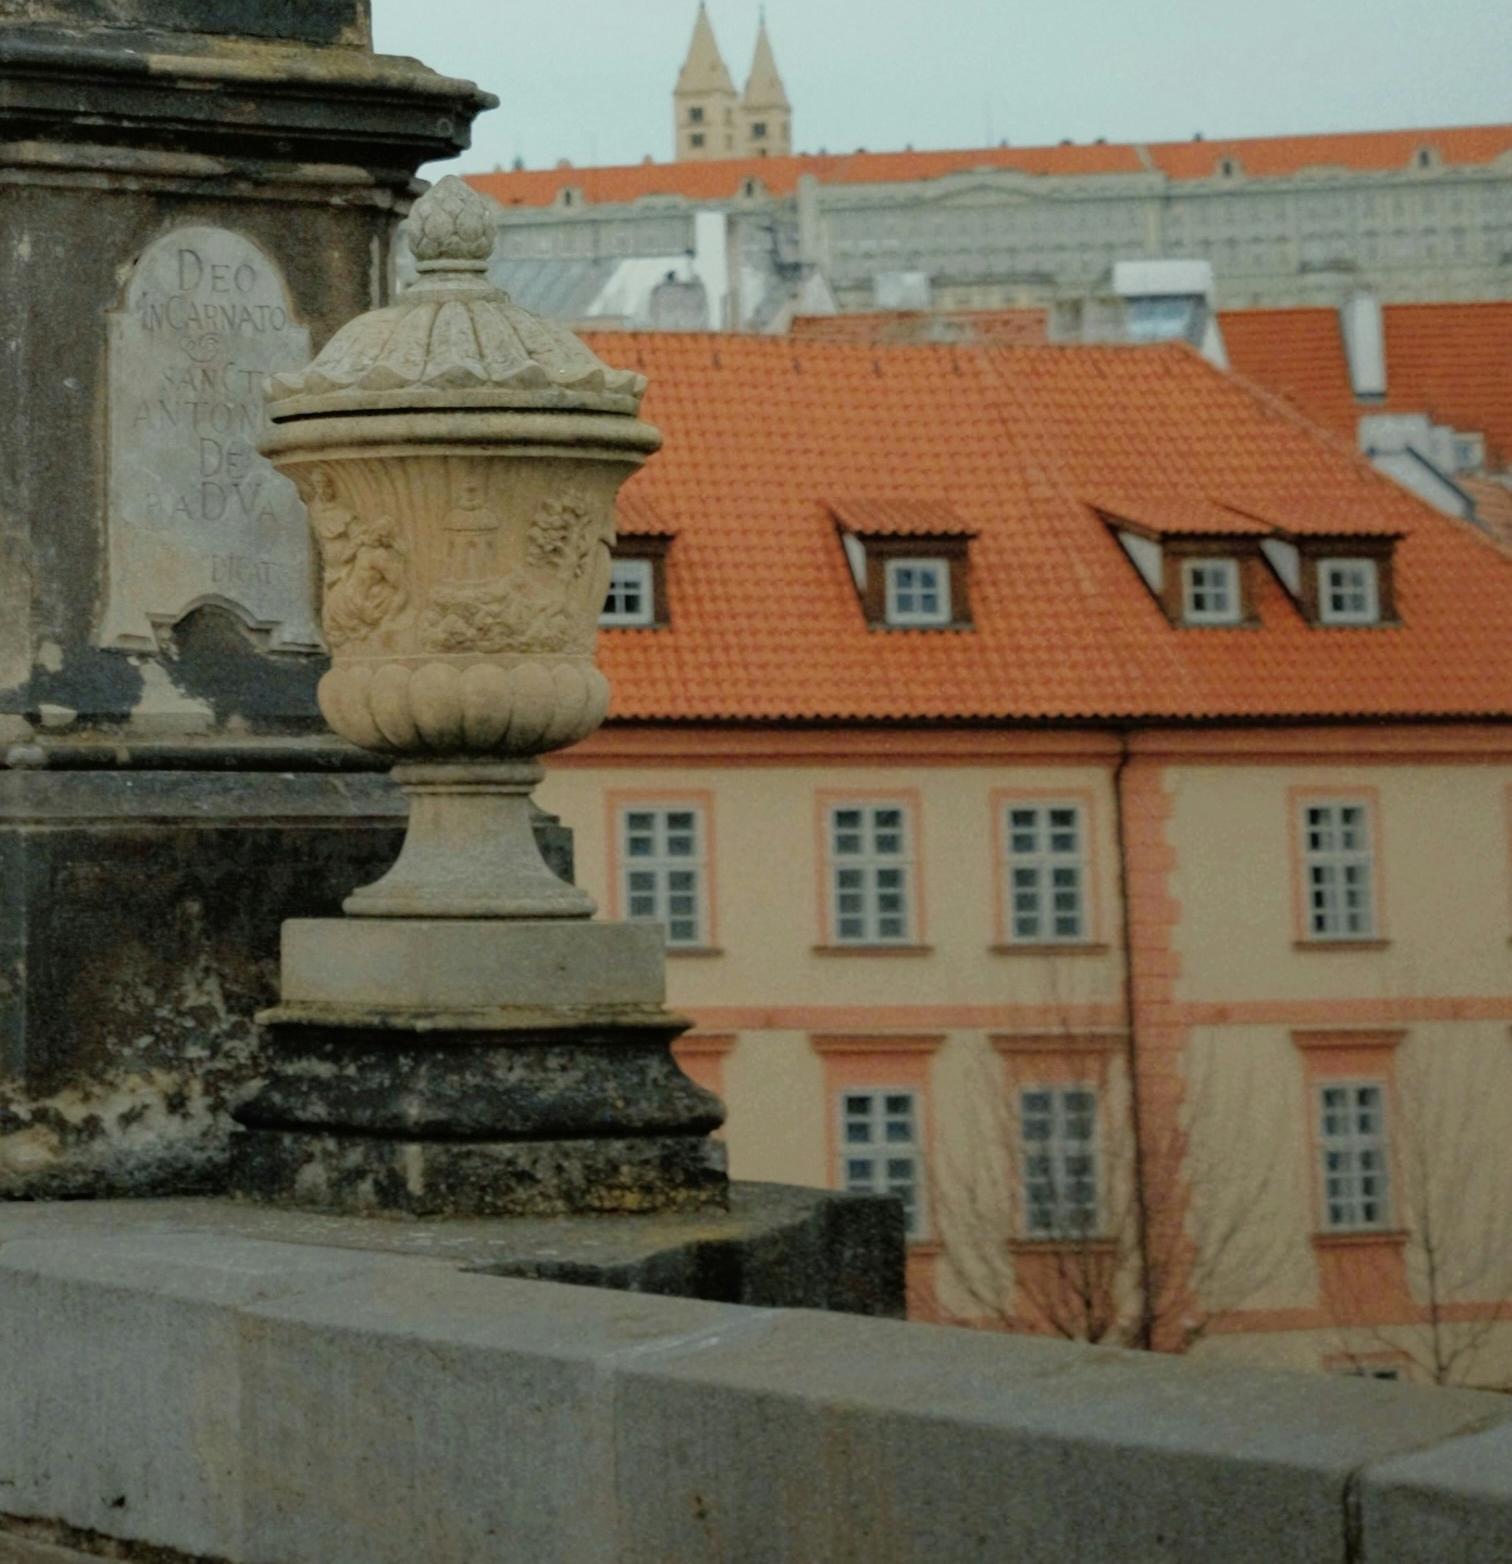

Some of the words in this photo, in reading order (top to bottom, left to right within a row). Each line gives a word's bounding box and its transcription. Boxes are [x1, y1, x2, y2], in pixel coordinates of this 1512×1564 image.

[162, 361, 265, 394] SANCT
[132, 399, 260, 435] ANTON
[199, 437, 250, 479] DE
